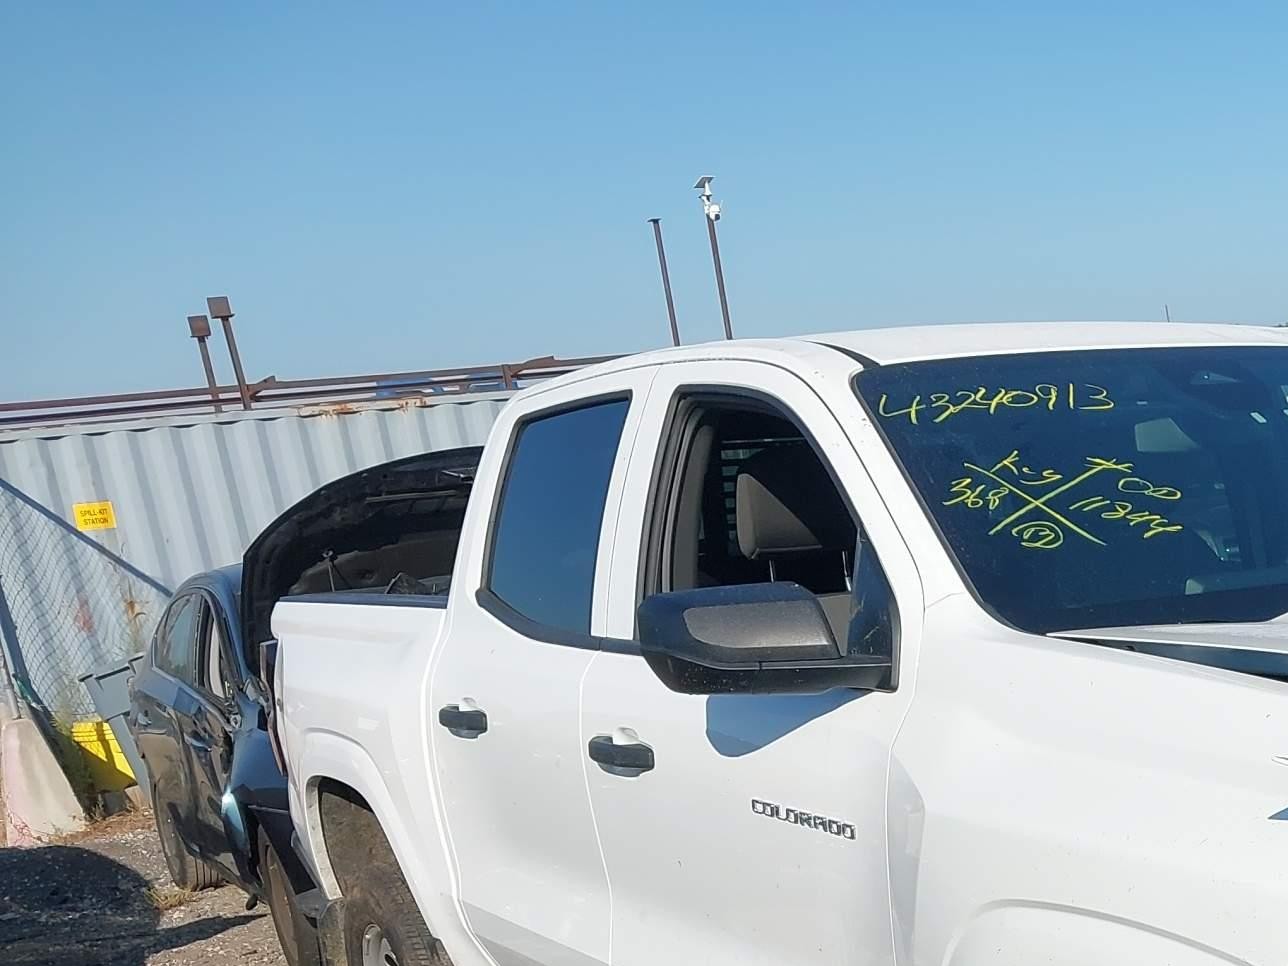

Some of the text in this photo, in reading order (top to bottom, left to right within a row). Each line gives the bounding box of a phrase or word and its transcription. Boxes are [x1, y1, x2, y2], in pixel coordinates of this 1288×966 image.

[878, 382, 1115, 425] 43240913
[83, 517, 109, 526] STATION
[751, 798, 857, 841] COLORADO
